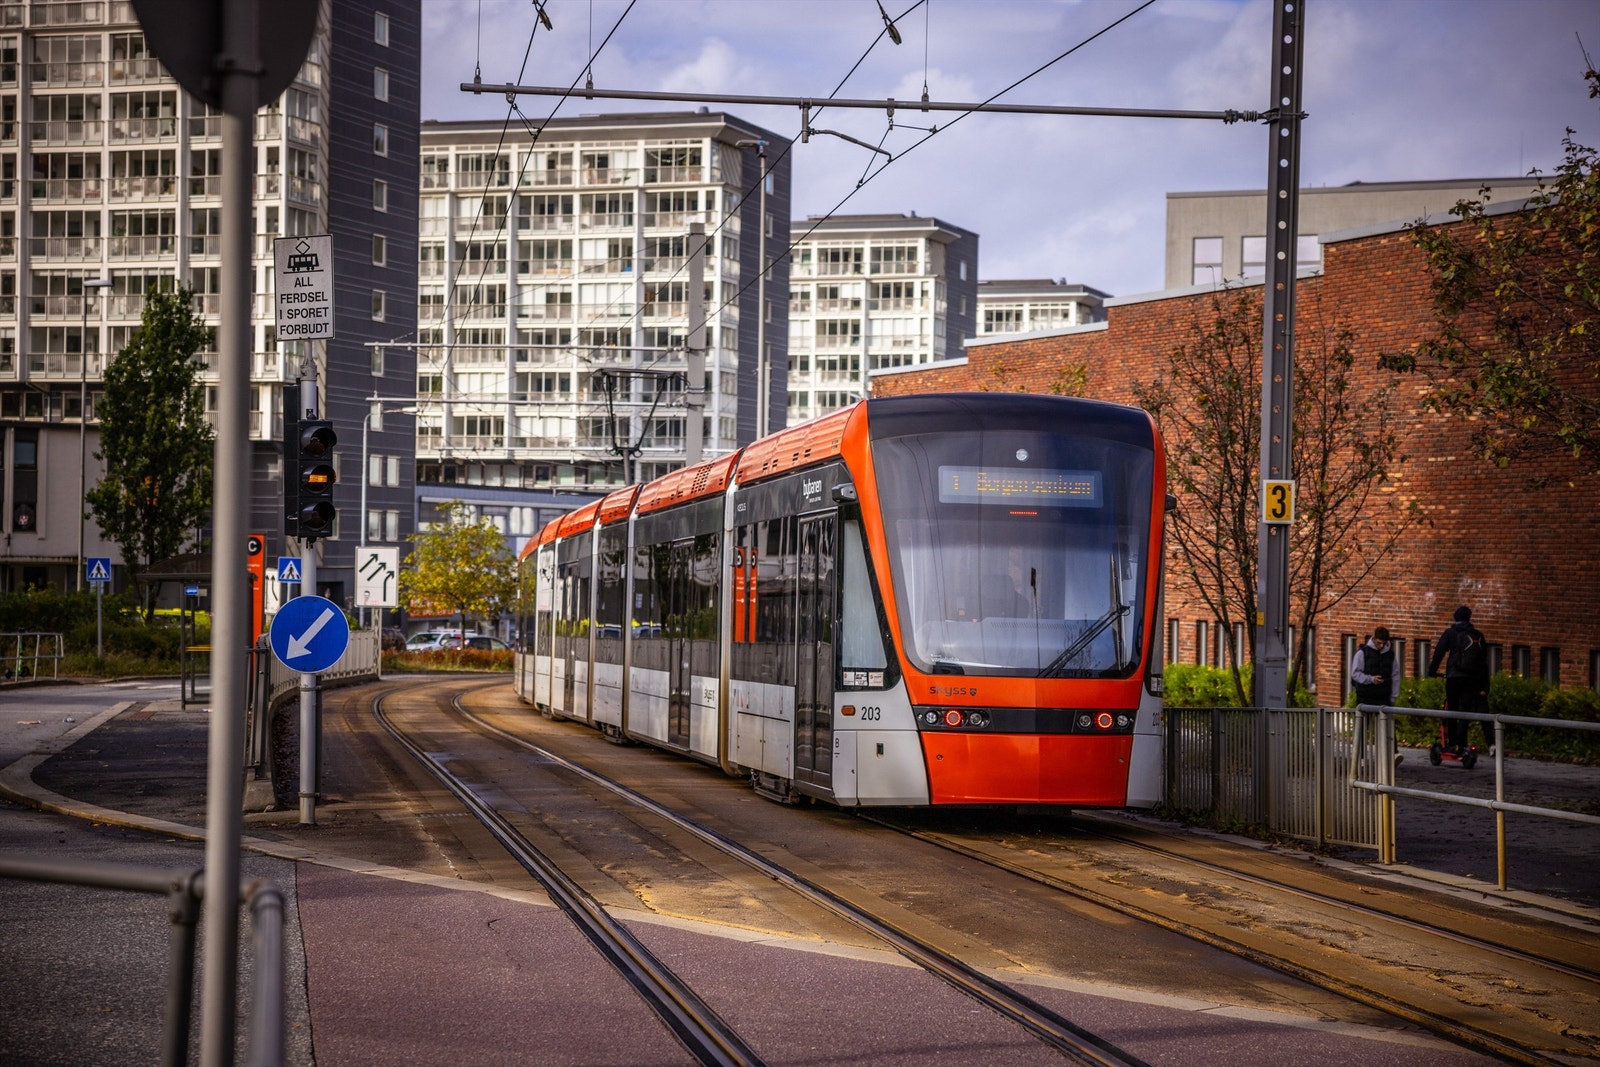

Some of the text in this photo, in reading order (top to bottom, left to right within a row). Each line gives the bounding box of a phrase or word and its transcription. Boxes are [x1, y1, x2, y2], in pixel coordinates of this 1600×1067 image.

[294, 276, 314, 288] ALL
[280, 291, 328, 304] FERDSEL
[279, 306, 329, 320] I SPORET
[280, 322, 329, 336] FORBUDT
[803, 478, 822, 500] bybanen
[1271, 484, 1286, 519] 3
[247, 540, 257, 552] C
[929, 683, 967, 698] skyss
[861, 706, 881, 721] 203
